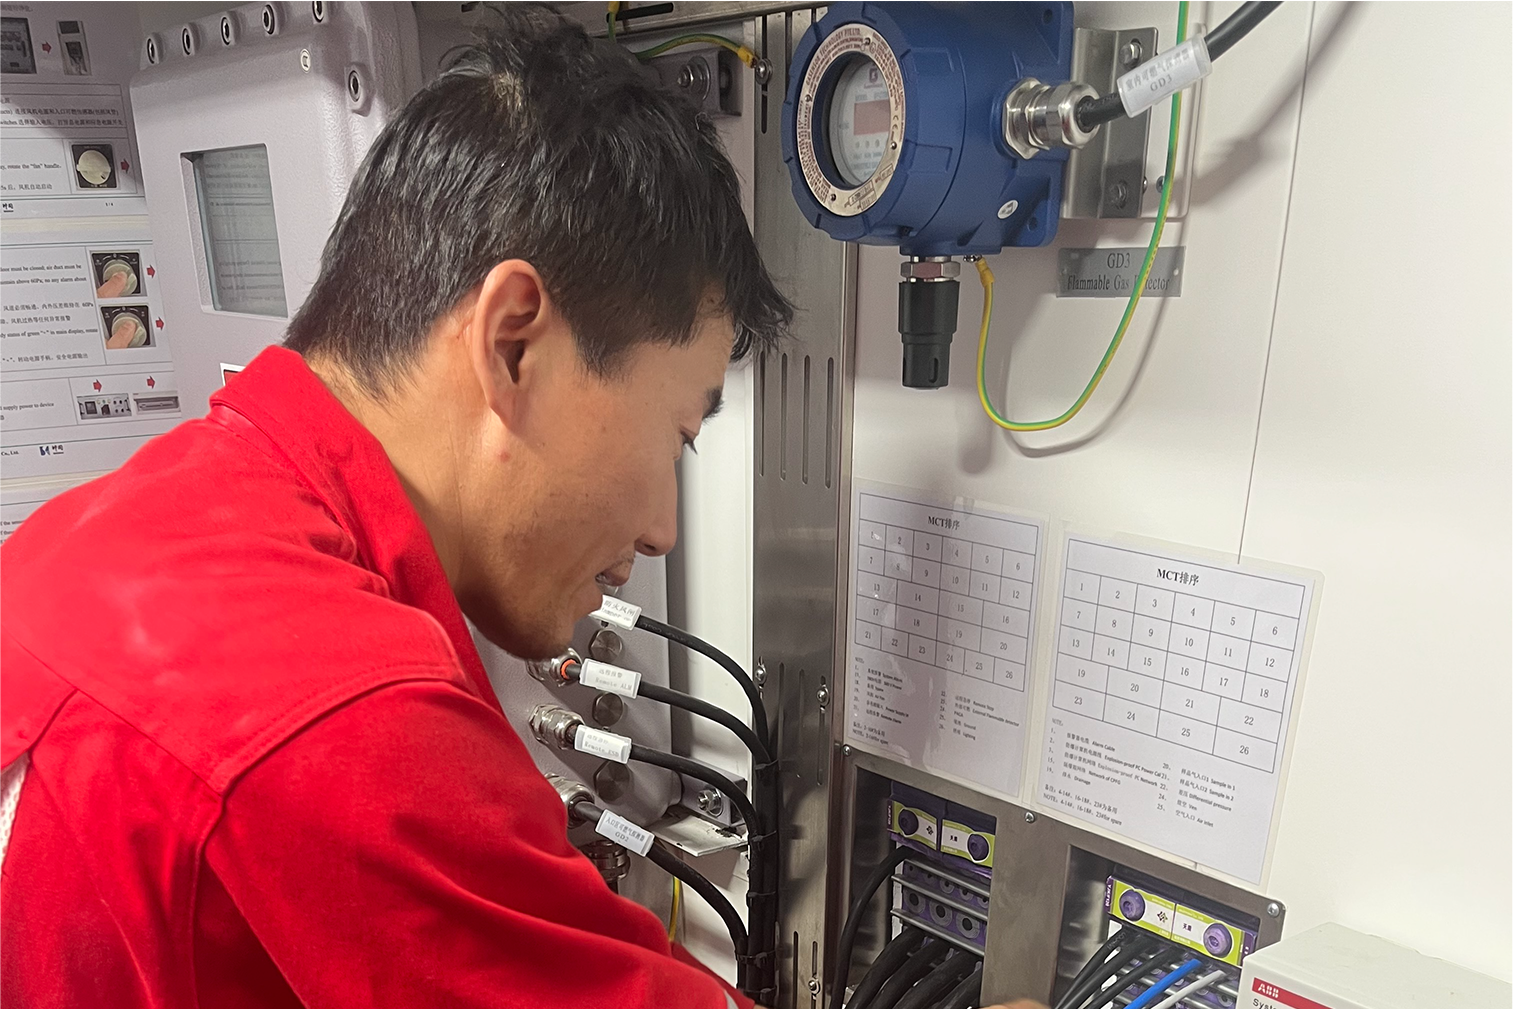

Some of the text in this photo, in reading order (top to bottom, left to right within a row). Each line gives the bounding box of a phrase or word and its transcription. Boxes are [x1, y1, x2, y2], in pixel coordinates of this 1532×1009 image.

[1150, 74, 1172, 91] GD3
[1107, 253, 1130, 268] GD3
[1068, 275, 1110, 290] Flammable
[1114, 275, 1129, 290] Gas
[928, 515, 960, 530] MCT排序
[1157, 568, 1199, 586] MCT排序
[982, 583, 987, 591] 11
[1081, 583, 1083, 591] 1
[1013, 591, 1019, 599] 12
[1116, 591, 1120, 599] 2
[1152, 599, 1157, 607] 3
[958, 604, 964, 612] 15
[1191, 608, 1195, 616] 4
[1231, 617, 1235, 625] 5
[865, 631, 871, 639] 21
[1149, 629, 1153, 637] 9
[1273, 627, 1277, 635] 6
[892, 639, 898, 647] 22
[1000, 642, 1007, 650] 20
[1073, 639, 1079, 647] 13
[1185, 638, 1193, 647] 10
[919, 646, 925, 654] 23
[1108, 648, 1114, 656] 14
[1225, 648, 1231, 657] 11
[1144, 657, 1151, 666] 15
[1266, 658, 1274, 667] 12
[976, 662, 982, 670] 25
[1006, 671, 1013, 679] 26
[1078, 669, 1085, 677] 19
[1181, 667, 1189, 676] 16
[1220, 678, 1228, 686] 17
[1131, 683, 1139, 692] 20
[1260, 689, 1269, 698] 18
[1074, 696, 1082, 705] 23
[1186, 699, 1193, 708] 21
[1127, 712, 1135, 720] 24
[1244, 716, 1254, 725] 22
[1182, 728, 1190, 737] 25
[1240, 746, 1249, 755] 26
[1258, 983, 1279, 998] ABB
